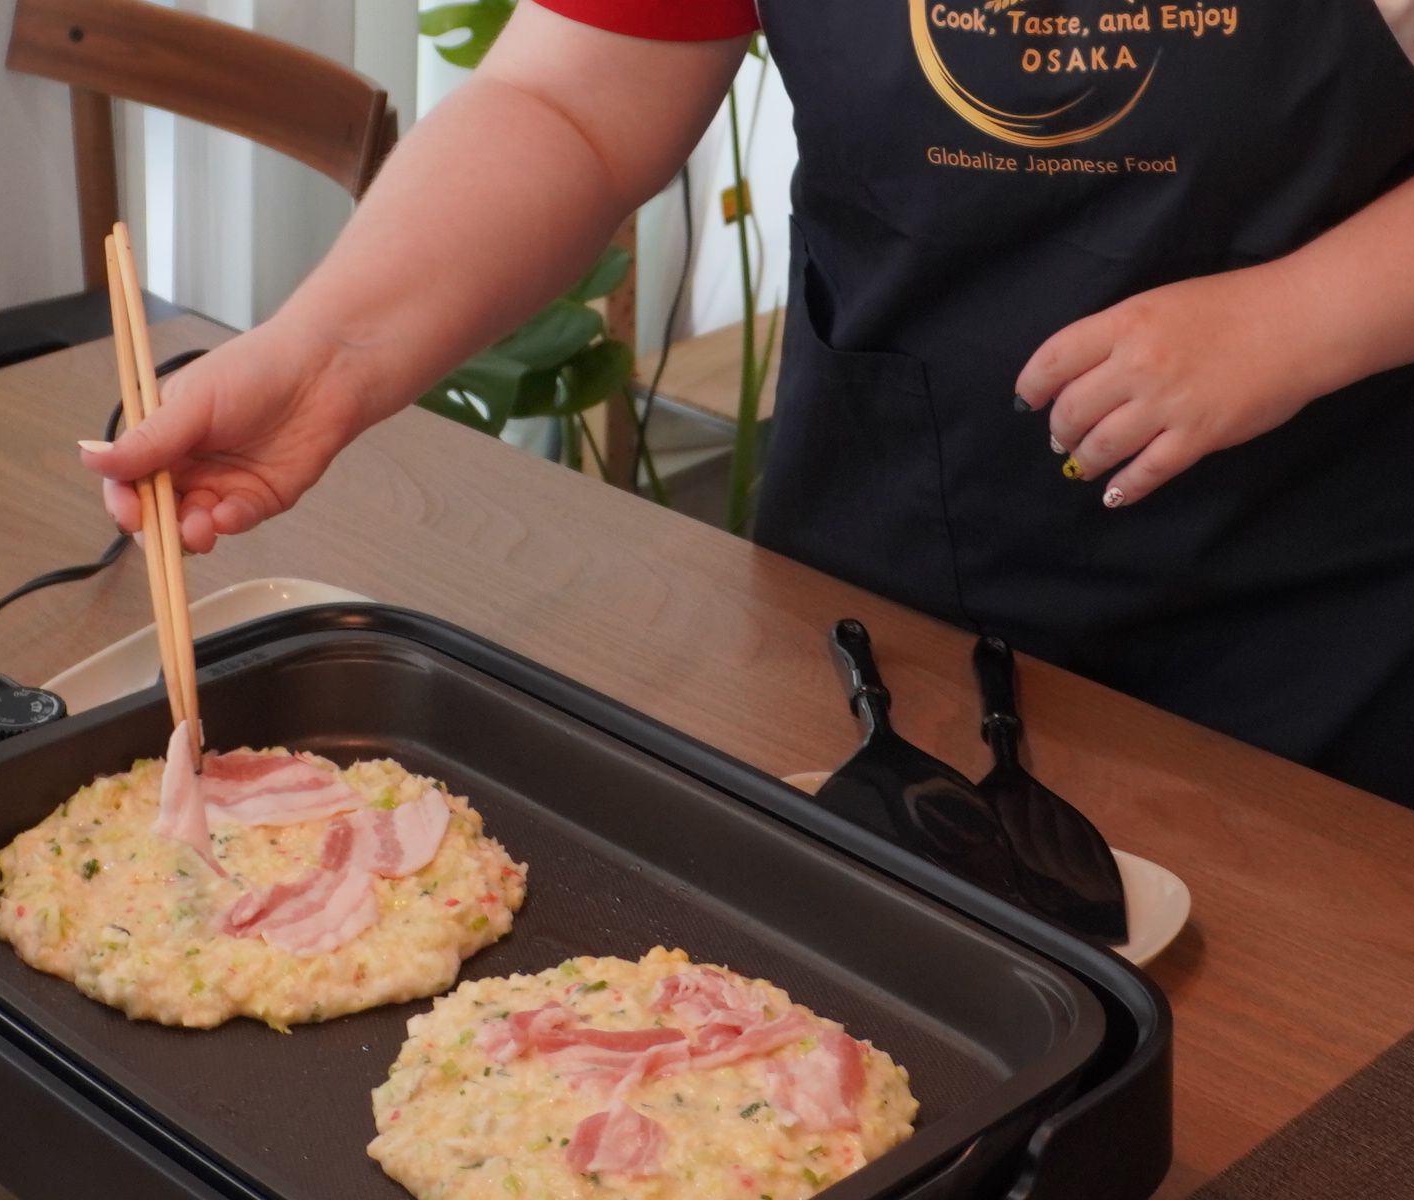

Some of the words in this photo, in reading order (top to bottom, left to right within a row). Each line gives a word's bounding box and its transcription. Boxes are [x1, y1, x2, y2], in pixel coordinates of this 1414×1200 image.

[931, 3, 996, 36] Cook,
[1008, 11, 1089, 36] Taste,
[1099, 7, 1150, 32] and
[1161, 3, 1239, 36] Enjoy
[1021, 46, 1137, 73] OSAKA
[927, 146, 1018, 172] Globalize
[1025, 154, 1118, 175] Japanese
[1125, 156, 1177, 173] Food
